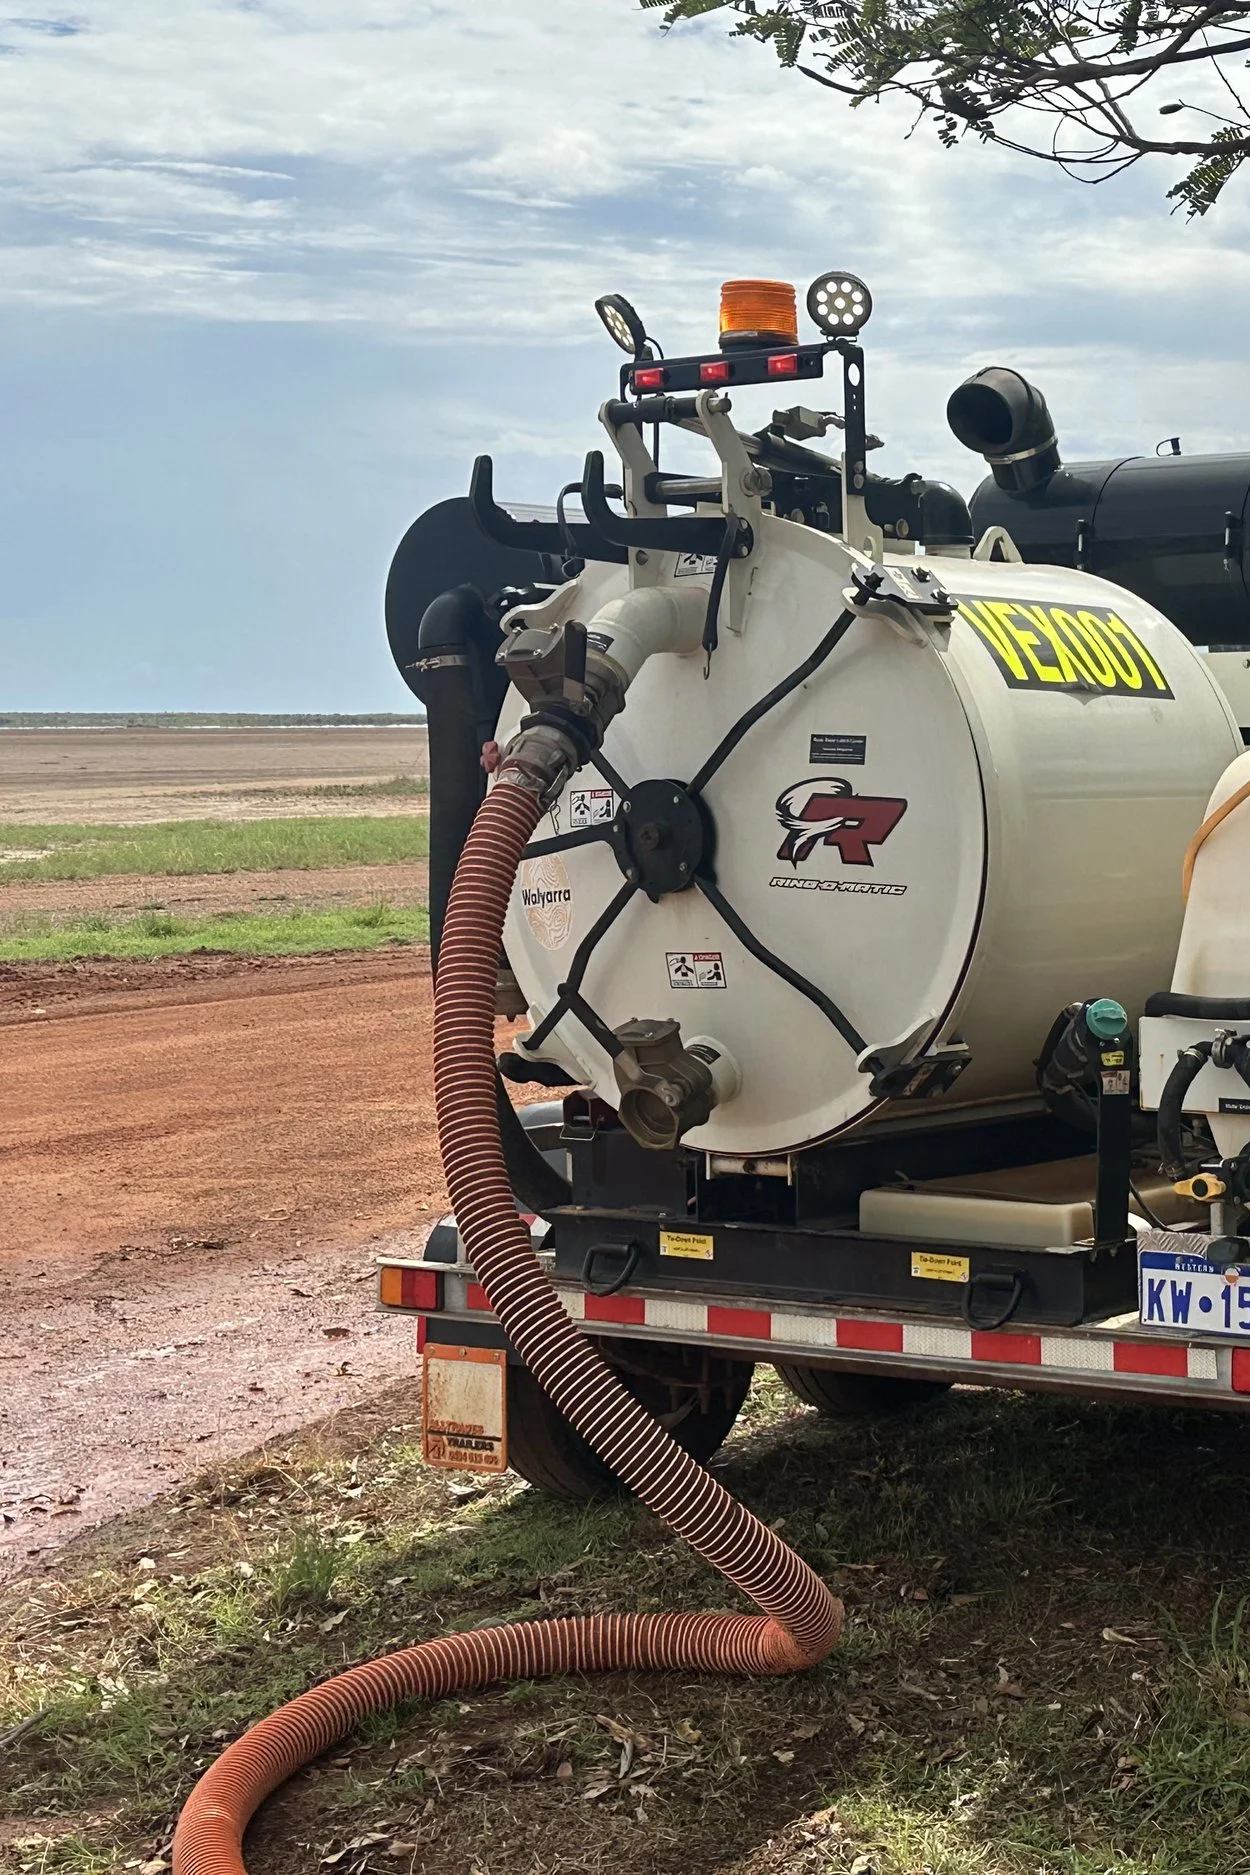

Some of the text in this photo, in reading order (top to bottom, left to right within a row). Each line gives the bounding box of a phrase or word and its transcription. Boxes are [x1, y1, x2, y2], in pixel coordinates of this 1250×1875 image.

[956, 599, 1167, 691] VEX001
[769, 877, 908, 896] RING-O-MATIC
[522, 887, 572, 908] Walyarra
